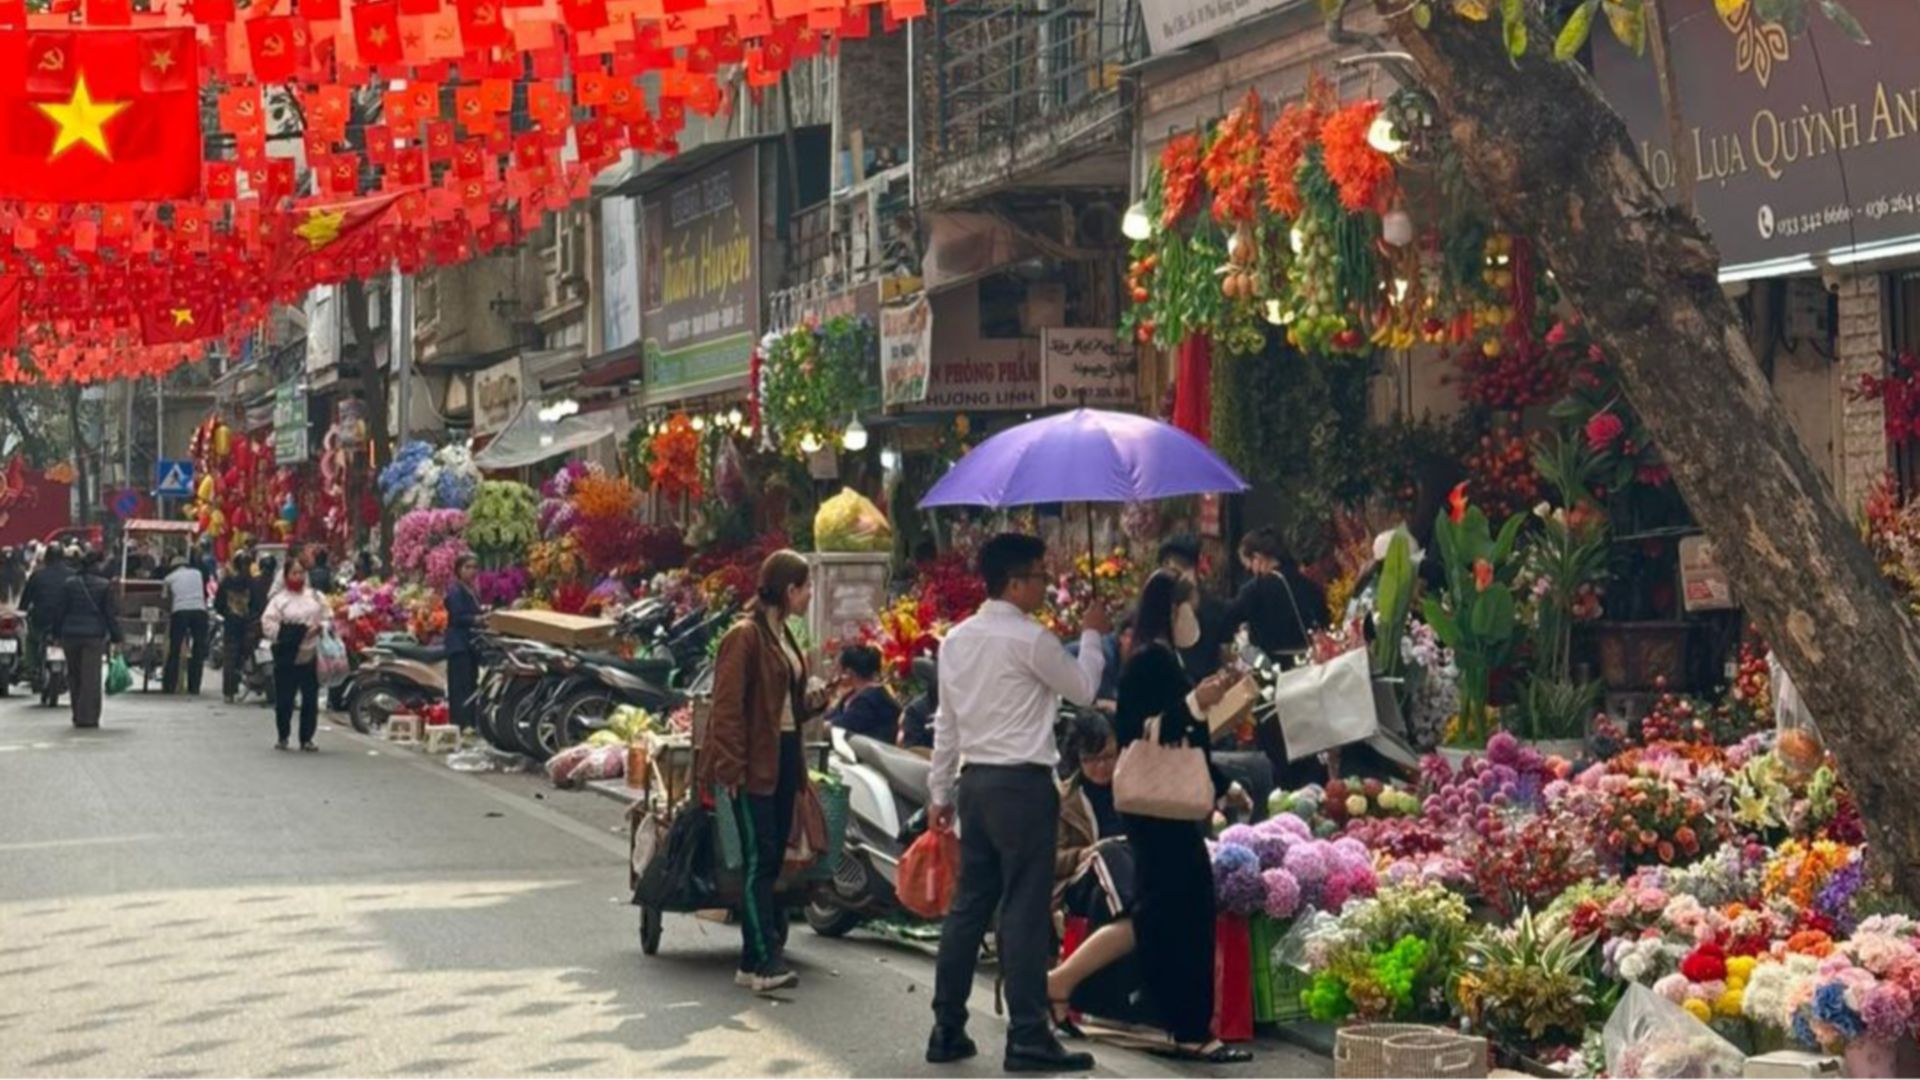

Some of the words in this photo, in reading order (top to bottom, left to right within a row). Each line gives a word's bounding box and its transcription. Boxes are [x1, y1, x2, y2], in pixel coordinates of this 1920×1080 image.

[1691, 127, 1748, 187] LỤA
[1751, 105, 1860, 180] QUỲNH
[1867, 81, 1920, 143] AN
[699, 205, 751, 304] Huyền
[1776, 215, 1800, 237] 033
[1800, 211, 1823, 233] 342
